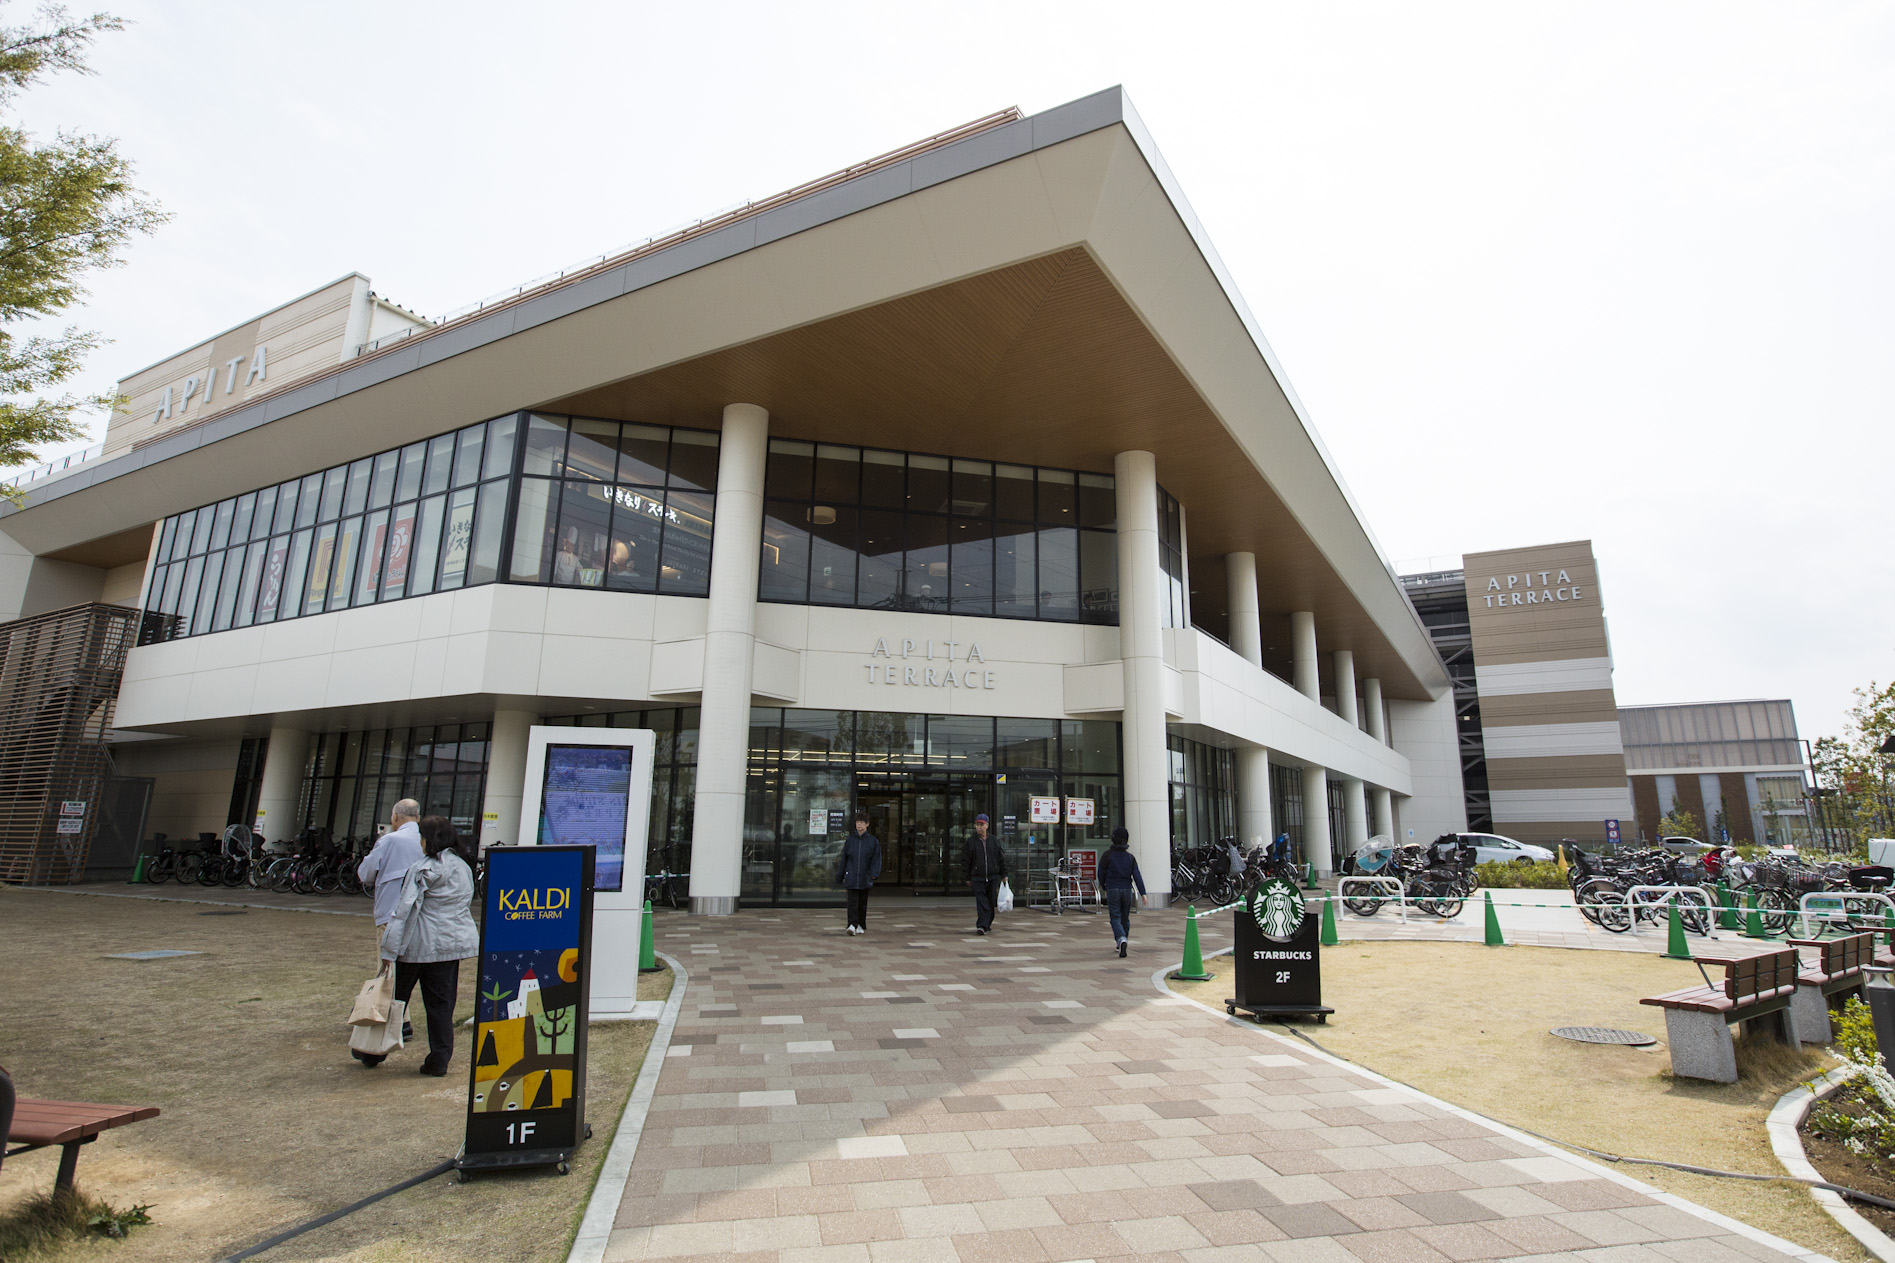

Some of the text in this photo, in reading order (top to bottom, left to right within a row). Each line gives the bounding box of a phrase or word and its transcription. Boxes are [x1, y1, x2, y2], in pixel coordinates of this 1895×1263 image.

[152, 345, 267, 424] APITA
[1487, 569, 1571, 592] APITA
[1483, 586, 1582, 608] TERRACE
[872, 637, 985, 663] APITA
[864, 664, 995, 690] TERRACE
[1070, 801, 1092, 809] カート
[499, 887, 571, 911] KALDI
[504, 910, 562, 920] COFFEE FARM
[1253, 950, 1312, 960] STARBUCKS
[1275, 971, 1291, 984] 2F
[506, 1121, 537, 1145] 1F
